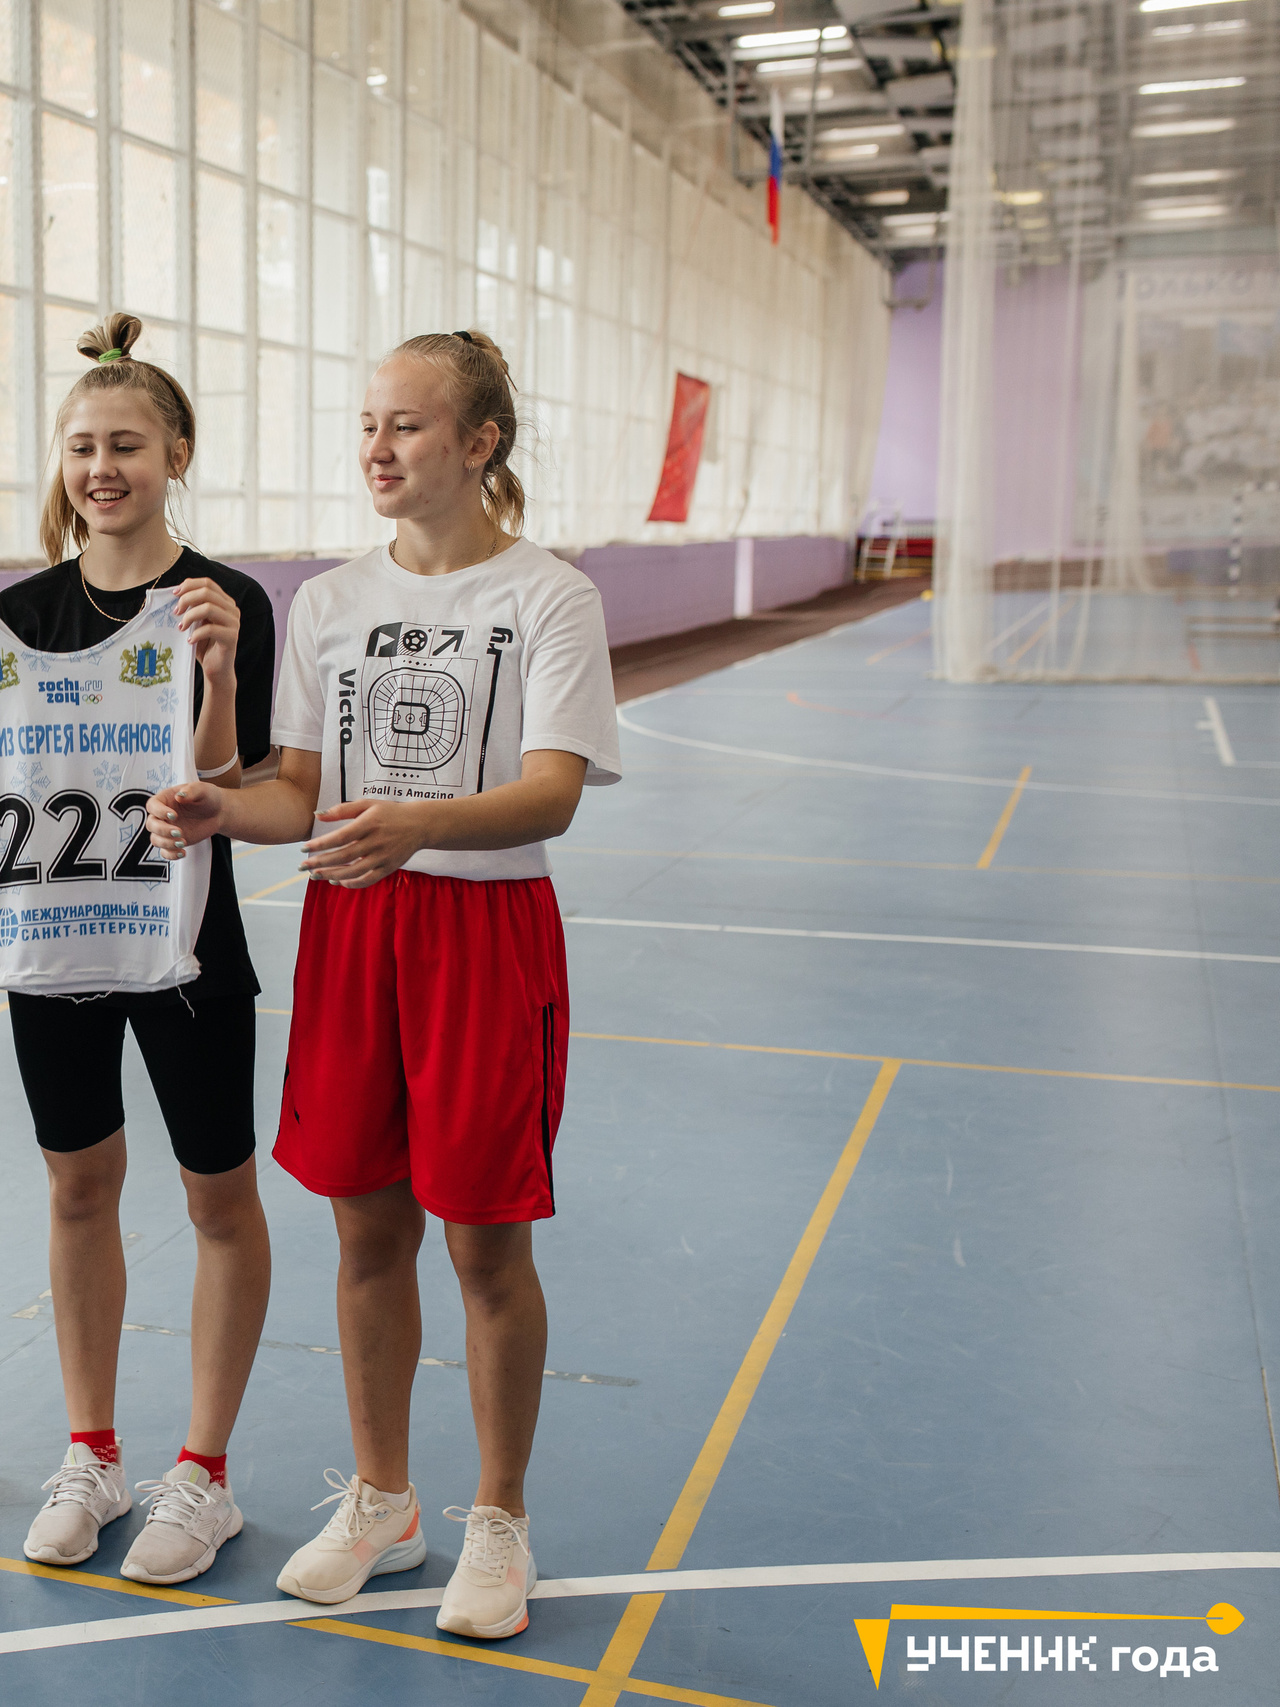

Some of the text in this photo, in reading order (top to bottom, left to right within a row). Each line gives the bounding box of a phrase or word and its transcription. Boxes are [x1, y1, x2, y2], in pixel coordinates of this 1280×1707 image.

[37, 677, 103, 692] sochi.ru
[338, 668, 357, 746] Victo
[17, 723, 74, 757] СЕРГЕЯ
[79, 722, 171, 757] БАЖАНОВА
[394, 787, 403, 796] is
[21, 901, 170, 922] МЕЖДУНАРОДНЫЙ БАНК
